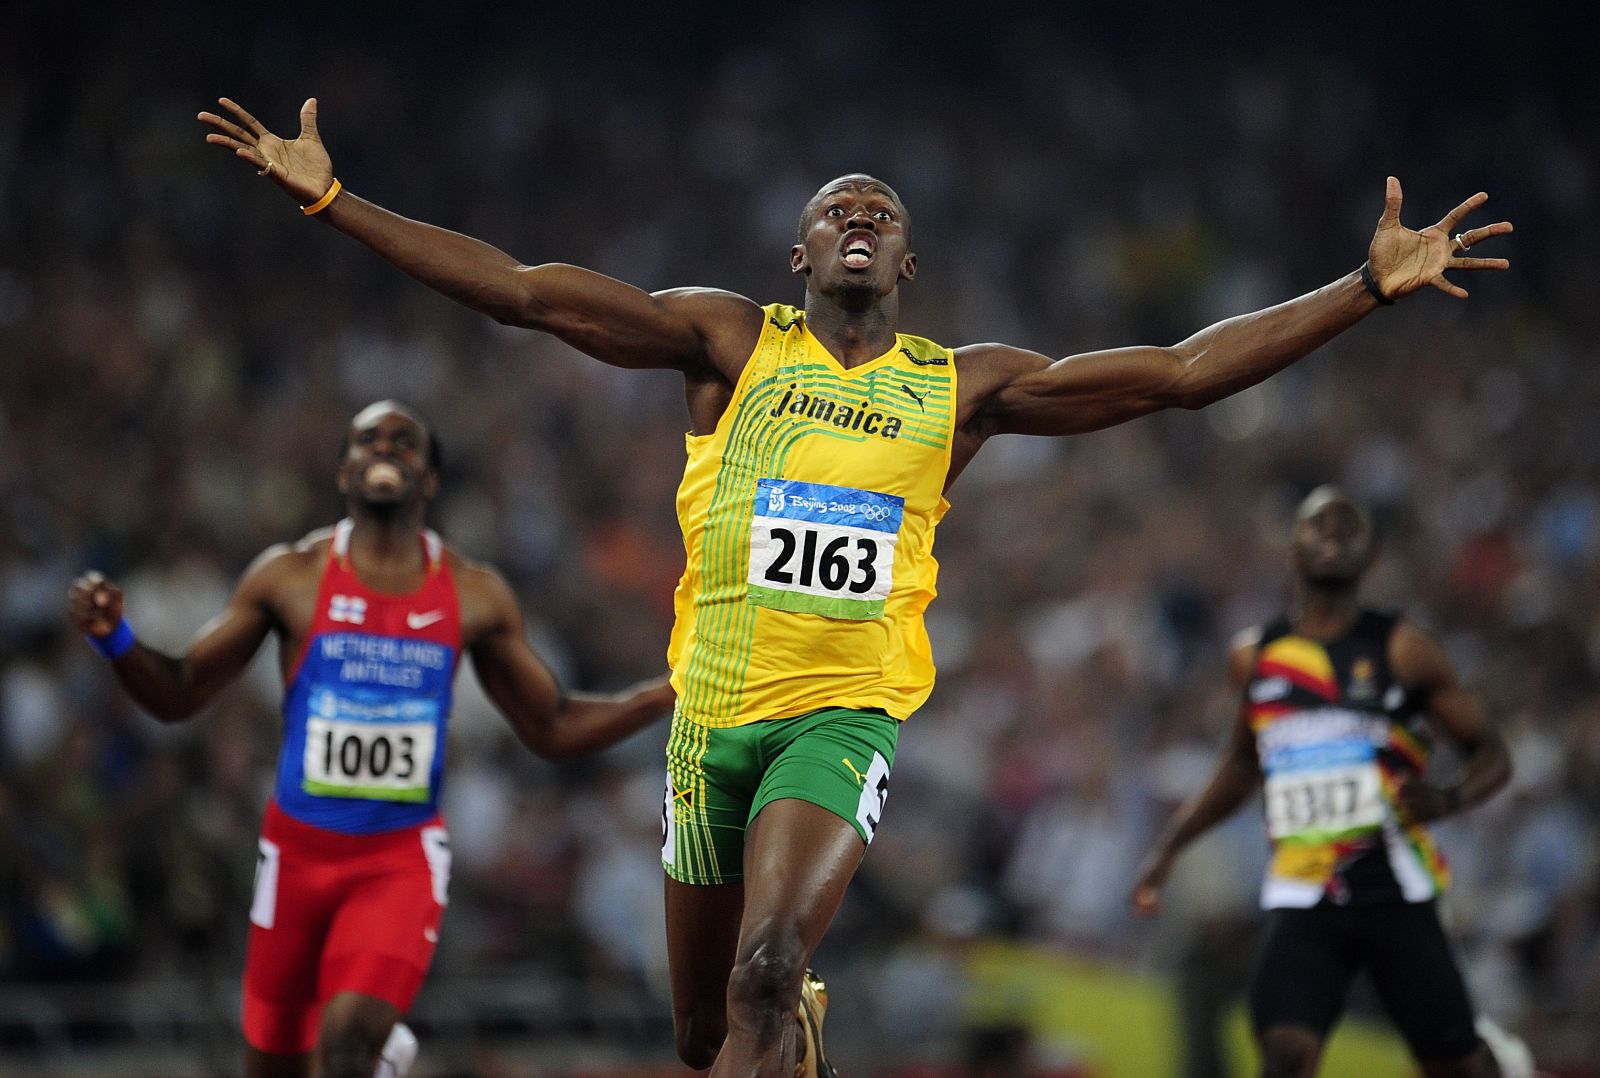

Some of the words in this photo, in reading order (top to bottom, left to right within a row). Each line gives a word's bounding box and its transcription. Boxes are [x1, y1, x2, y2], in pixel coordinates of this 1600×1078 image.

[770, 383, 902, 439] jamaica
[789, 495, 828, 514] Beijing
[830, 501, 856, 514] 2008
[764, 528, 878, 593] 2163
[324, 730, 415, 779] 1003
